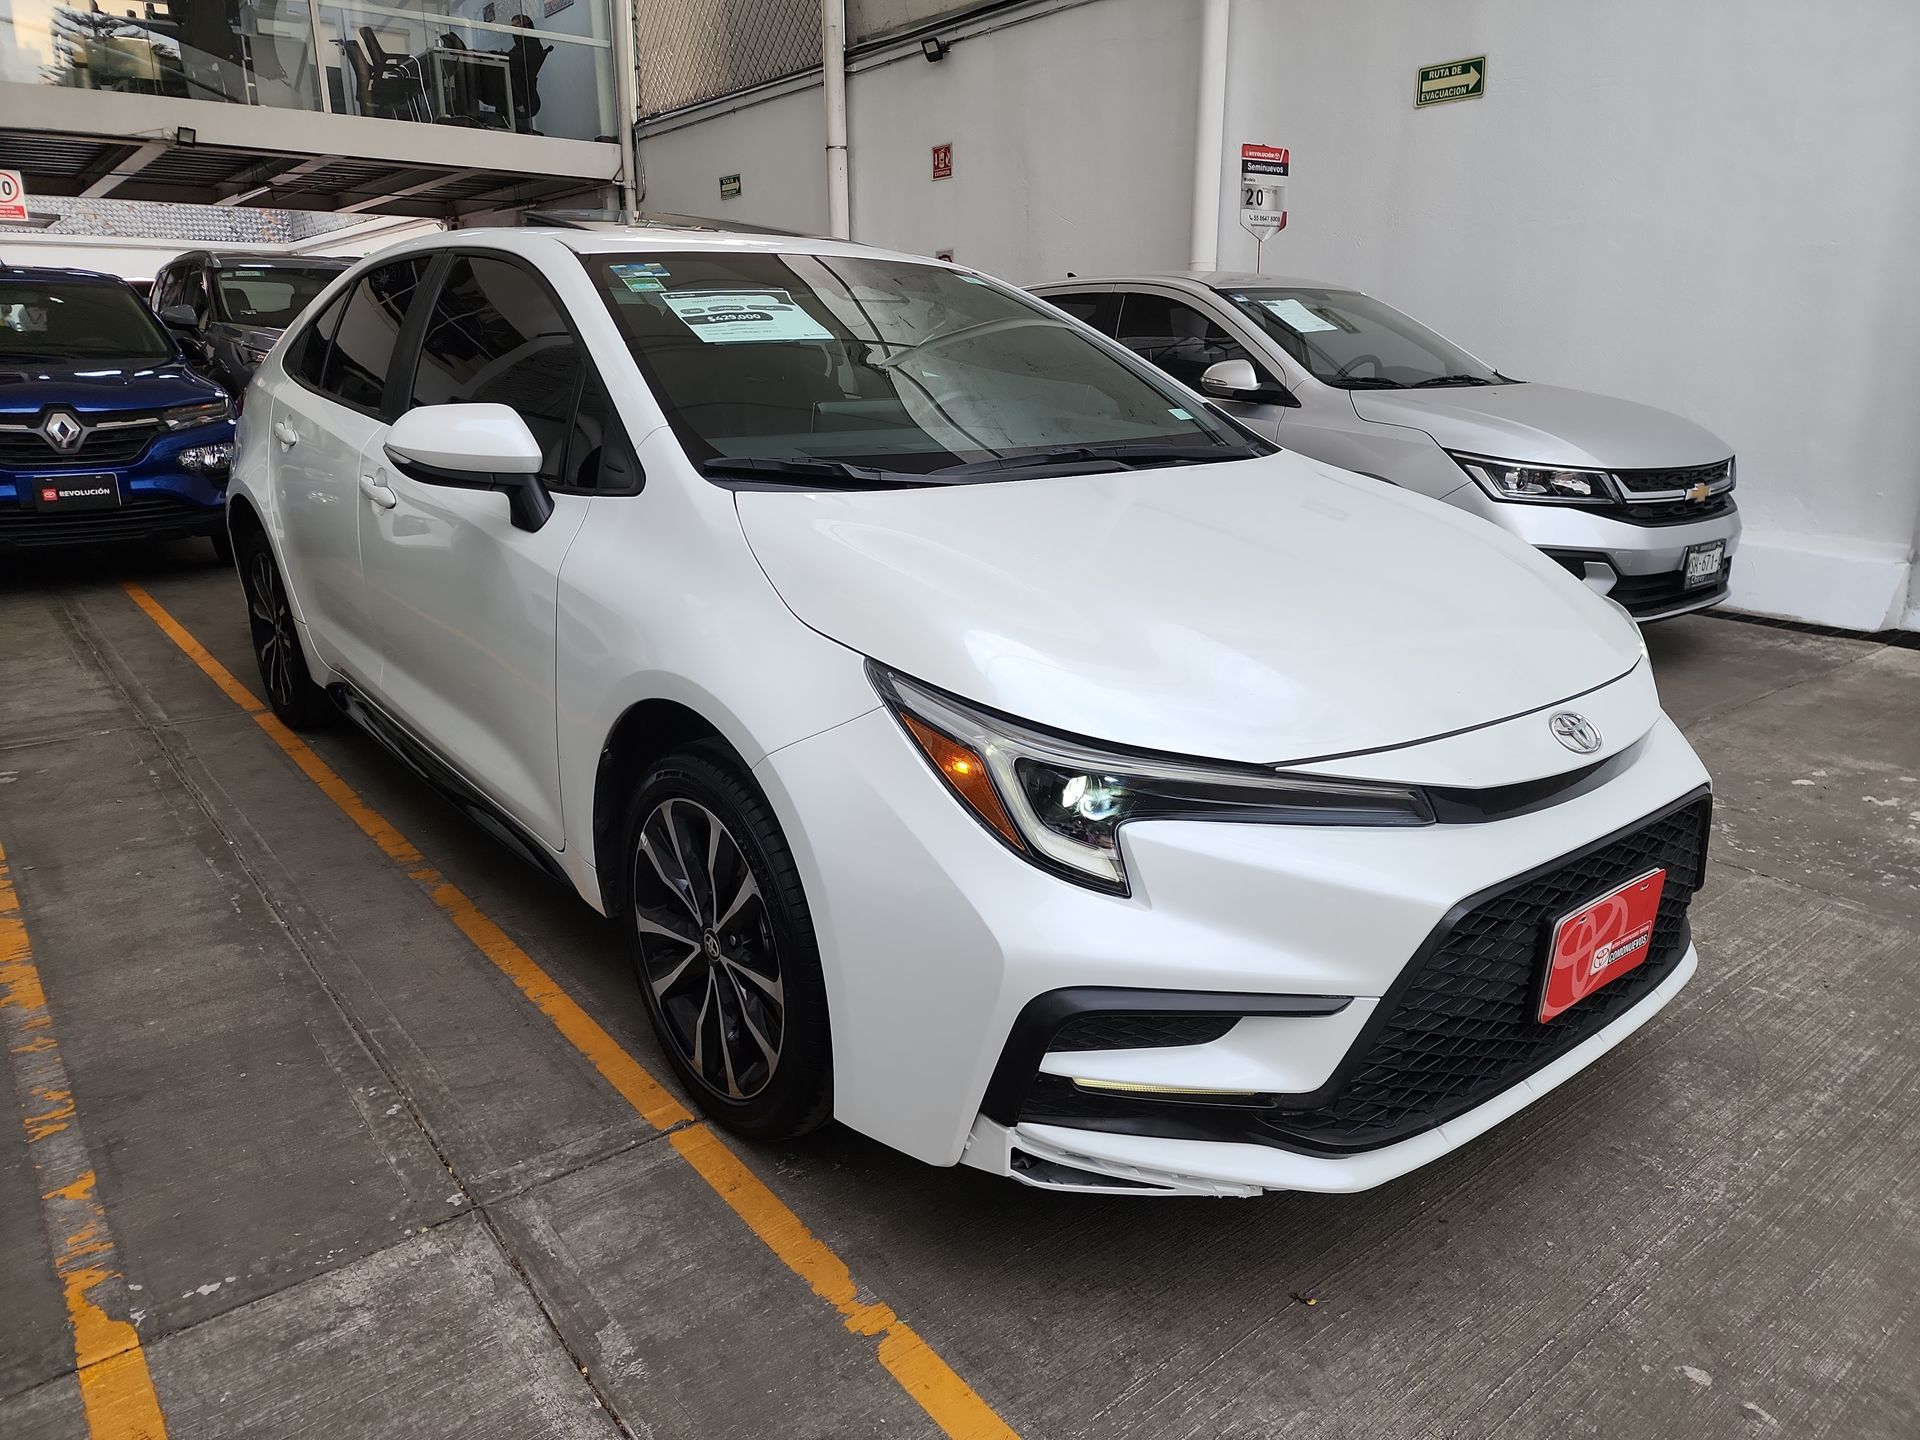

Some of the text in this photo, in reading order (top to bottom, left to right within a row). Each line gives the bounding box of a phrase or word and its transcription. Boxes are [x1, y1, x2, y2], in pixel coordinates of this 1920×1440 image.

[1428, 65, 1463, 79] RUTA DE
[1421, 86, 1467, 101] EVACUACION
[1247, 162, 1284, 173] Seminuevos
[707, 313, 761, 322] $429,000
[59, 488, 110, 497] REVOLUCIÓN
